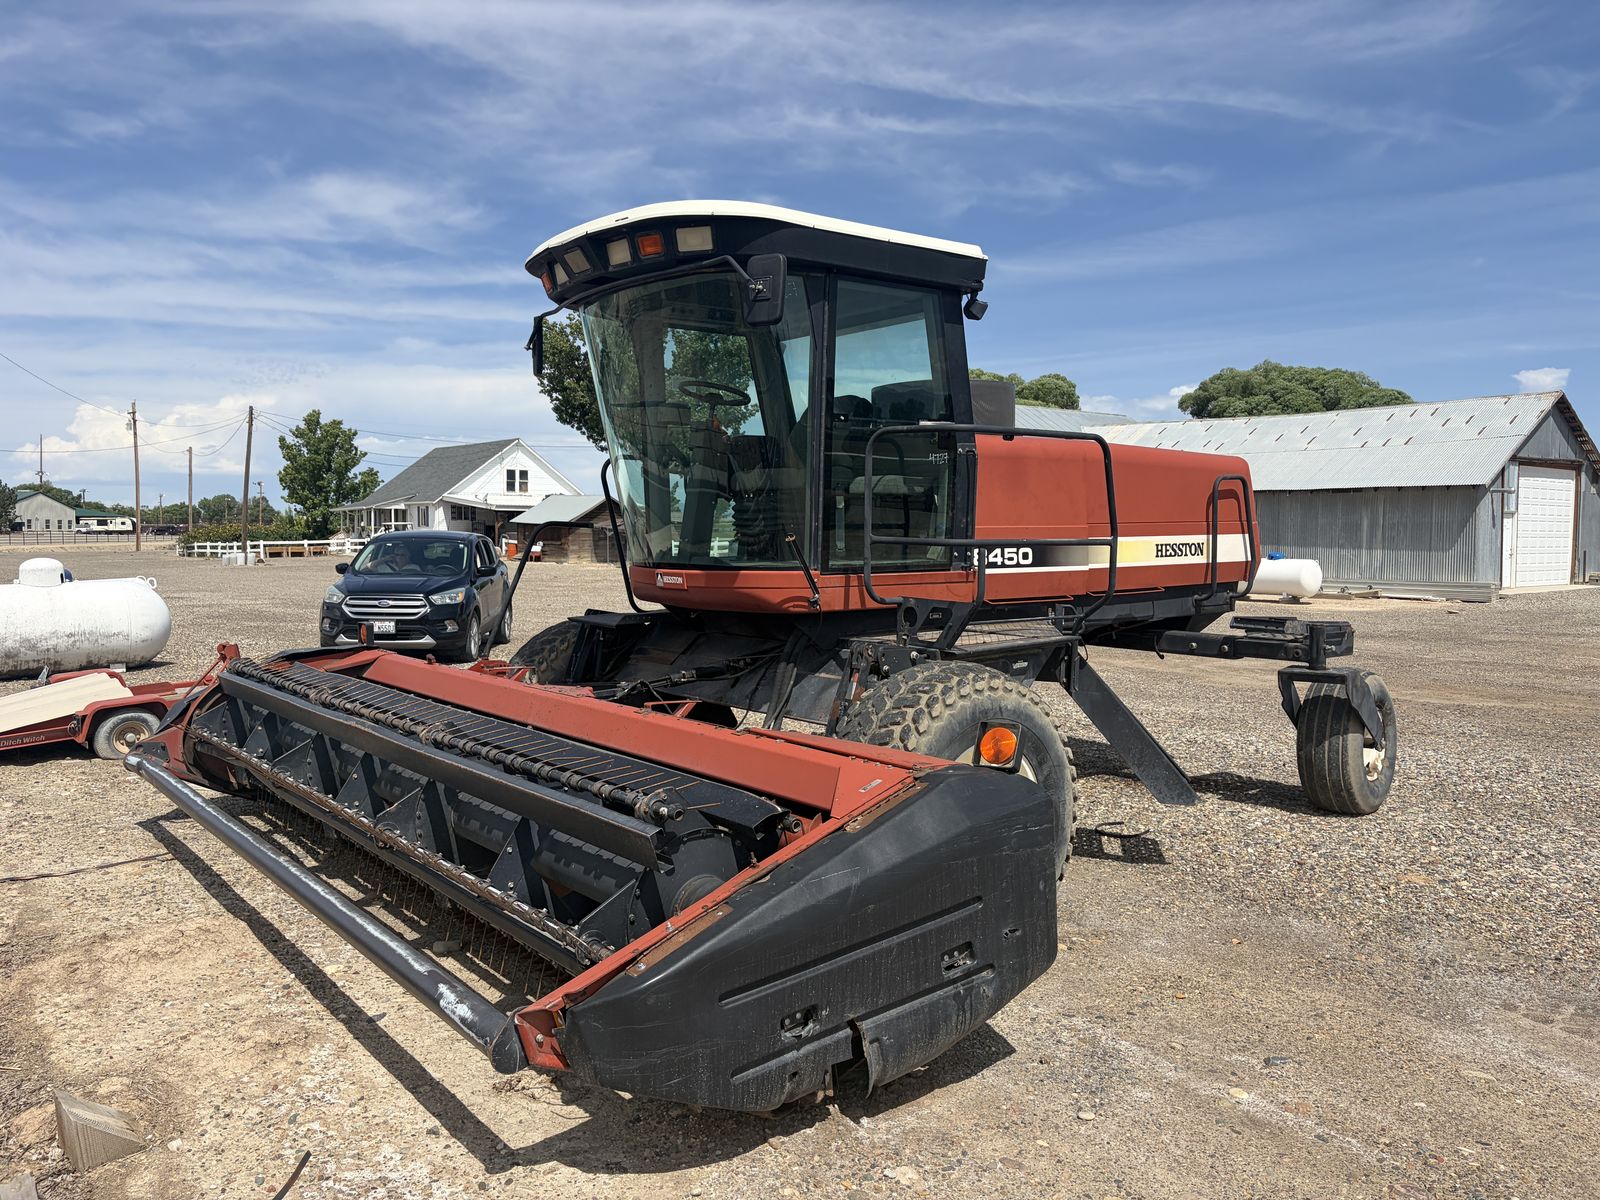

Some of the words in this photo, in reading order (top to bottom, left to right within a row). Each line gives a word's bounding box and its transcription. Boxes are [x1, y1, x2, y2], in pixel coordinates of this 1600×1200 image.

[1155, 542, 1205, 558] HESSTON
[0, 739, 21, 747] Ditch
[22, 735, 46, 744] Witch
